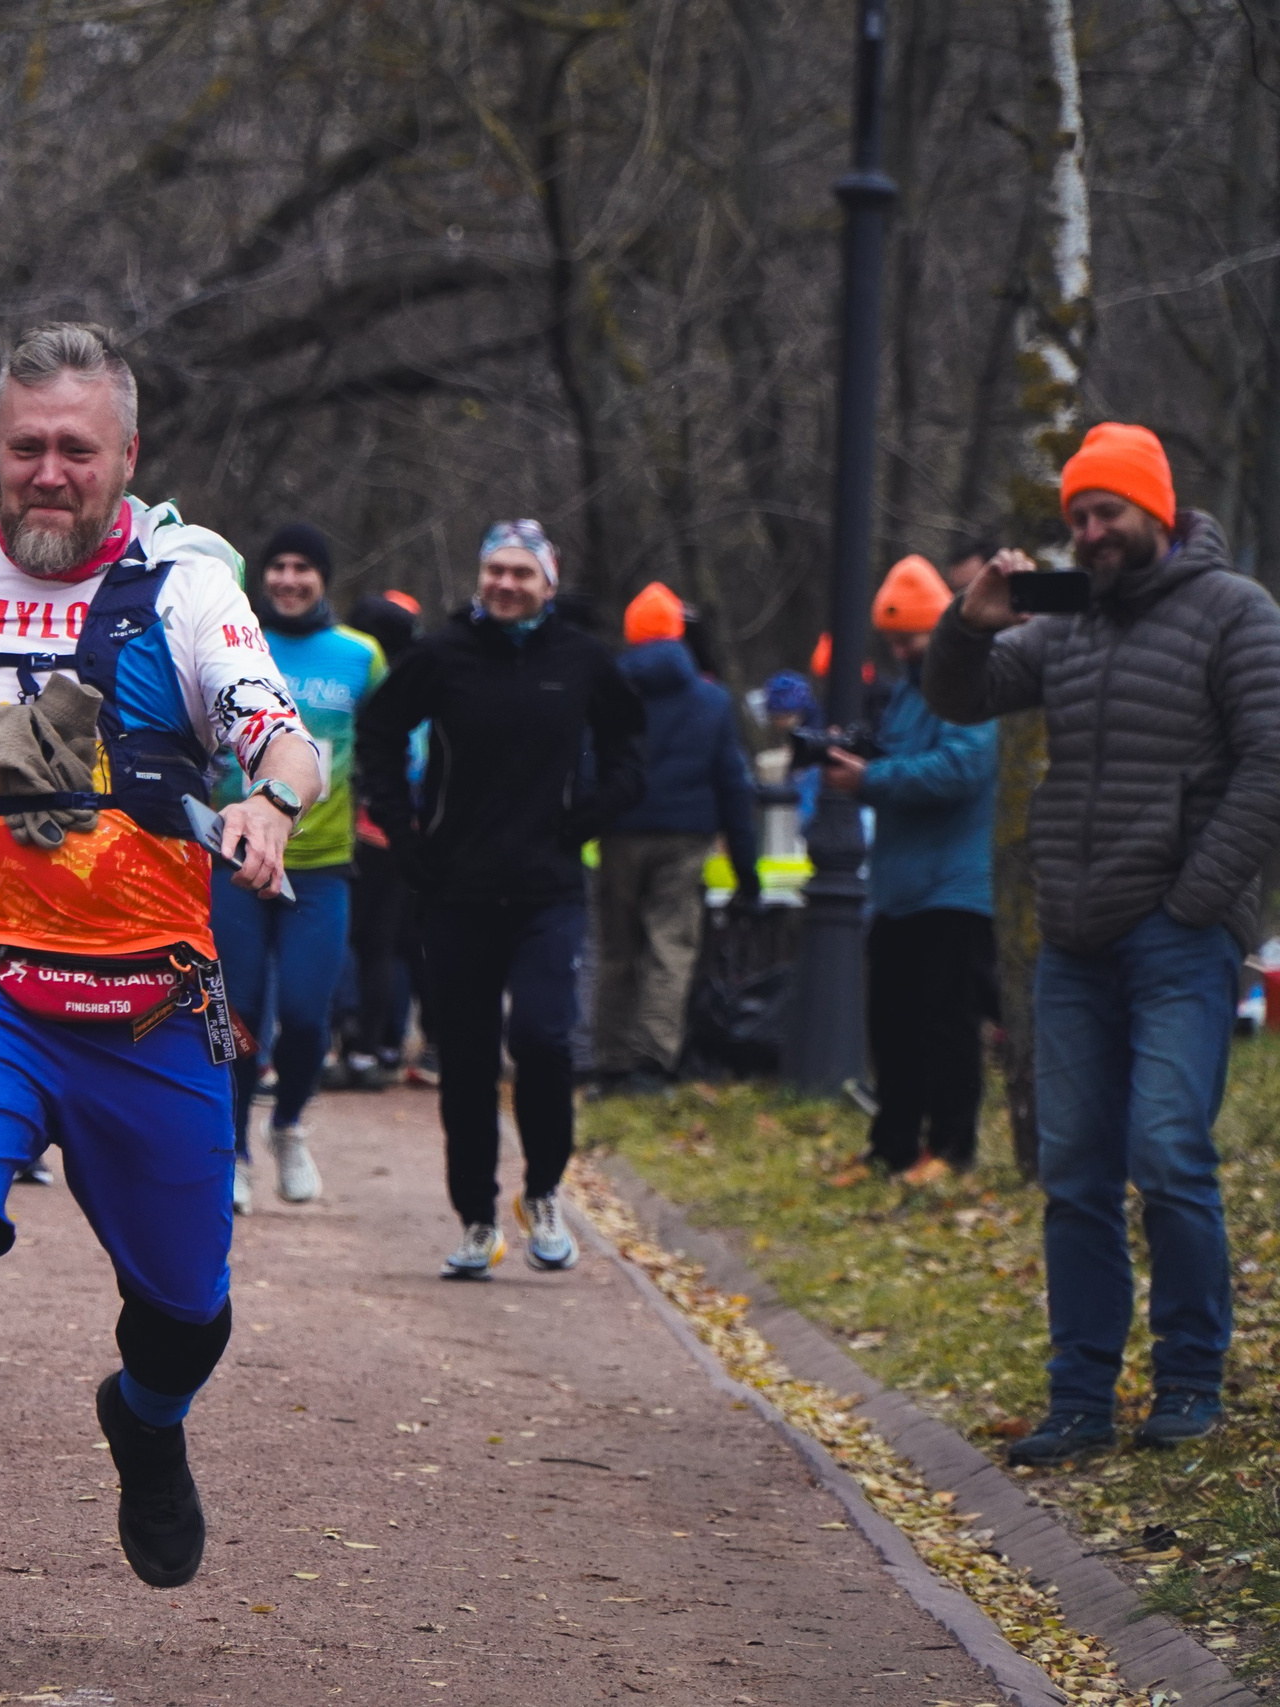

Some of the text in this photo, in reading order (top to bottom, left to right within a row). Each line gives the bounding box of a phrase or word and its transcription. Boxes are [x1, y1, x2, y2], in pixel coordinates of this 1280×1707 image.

[38, 970, 98, 988] ULTRA
[100, 973, 156, 987] TRAIL
[65, 1001, 110, 1013] FINISHER
[209, 1019, 221, 1045] FLIGHT
[216, 1004, 233, 1059] DRINK BEFORE
